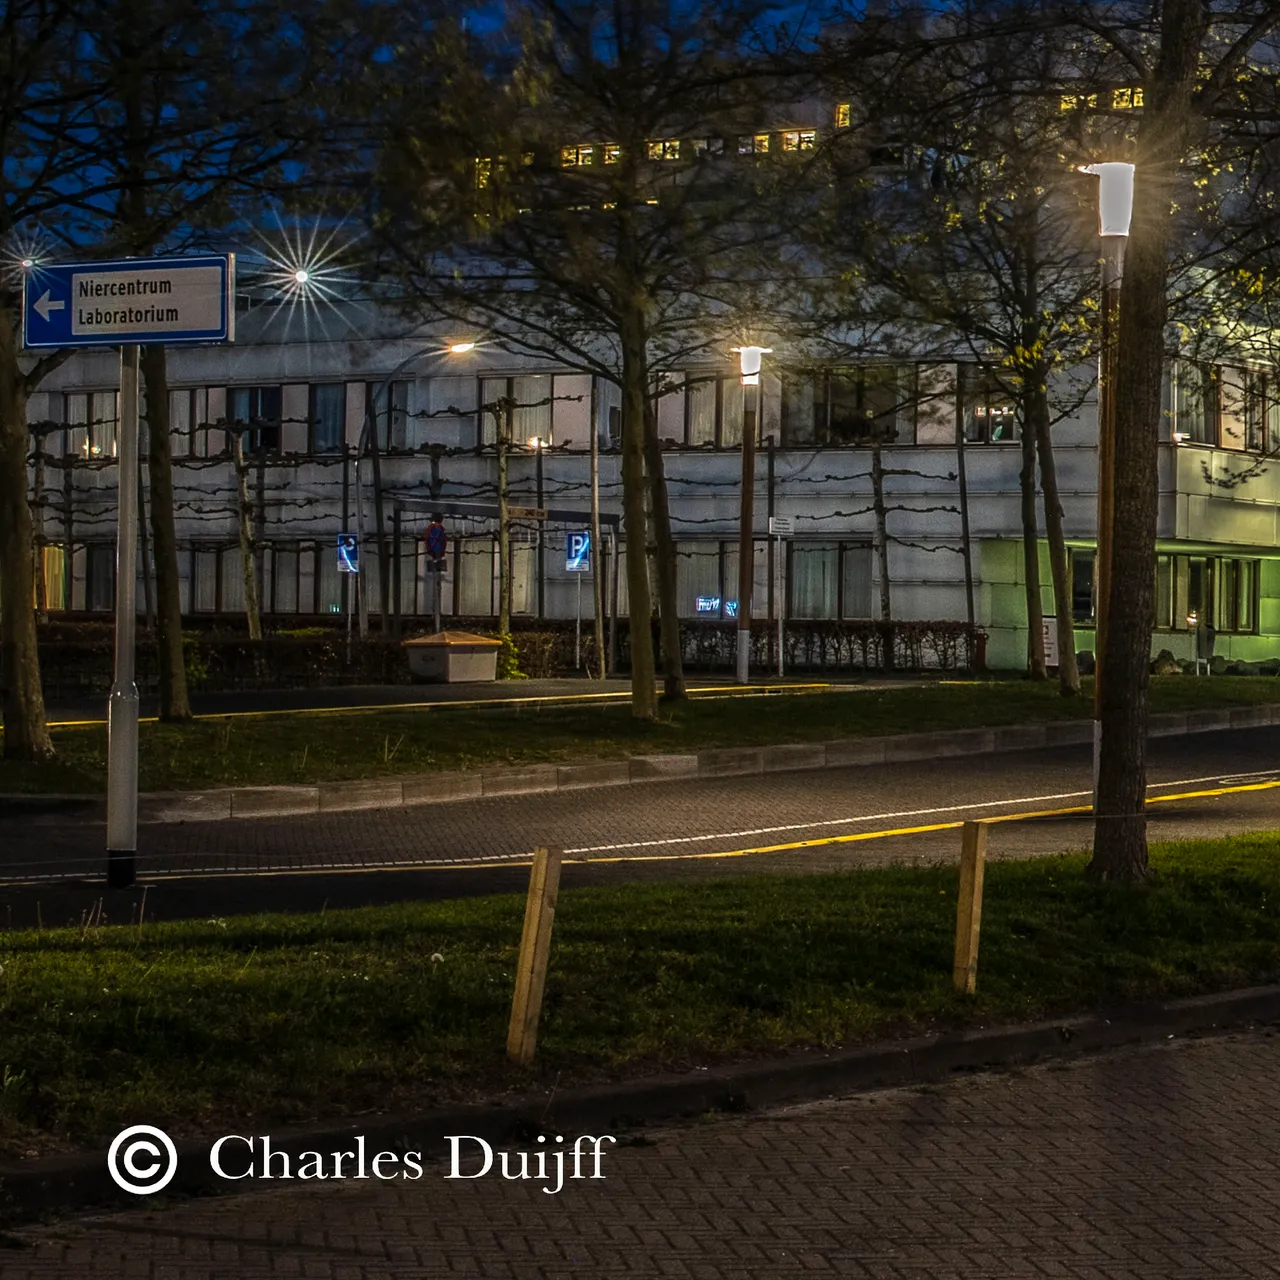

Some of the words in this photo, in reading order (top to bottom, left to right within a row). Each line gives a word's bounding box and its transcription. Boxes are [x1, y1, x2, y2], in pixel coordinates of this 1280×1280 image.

[79, 279, 172, 298] Niercentrum
[78, 305, 179, 325] Laboratorium
[571, 535, 584, 558] P
